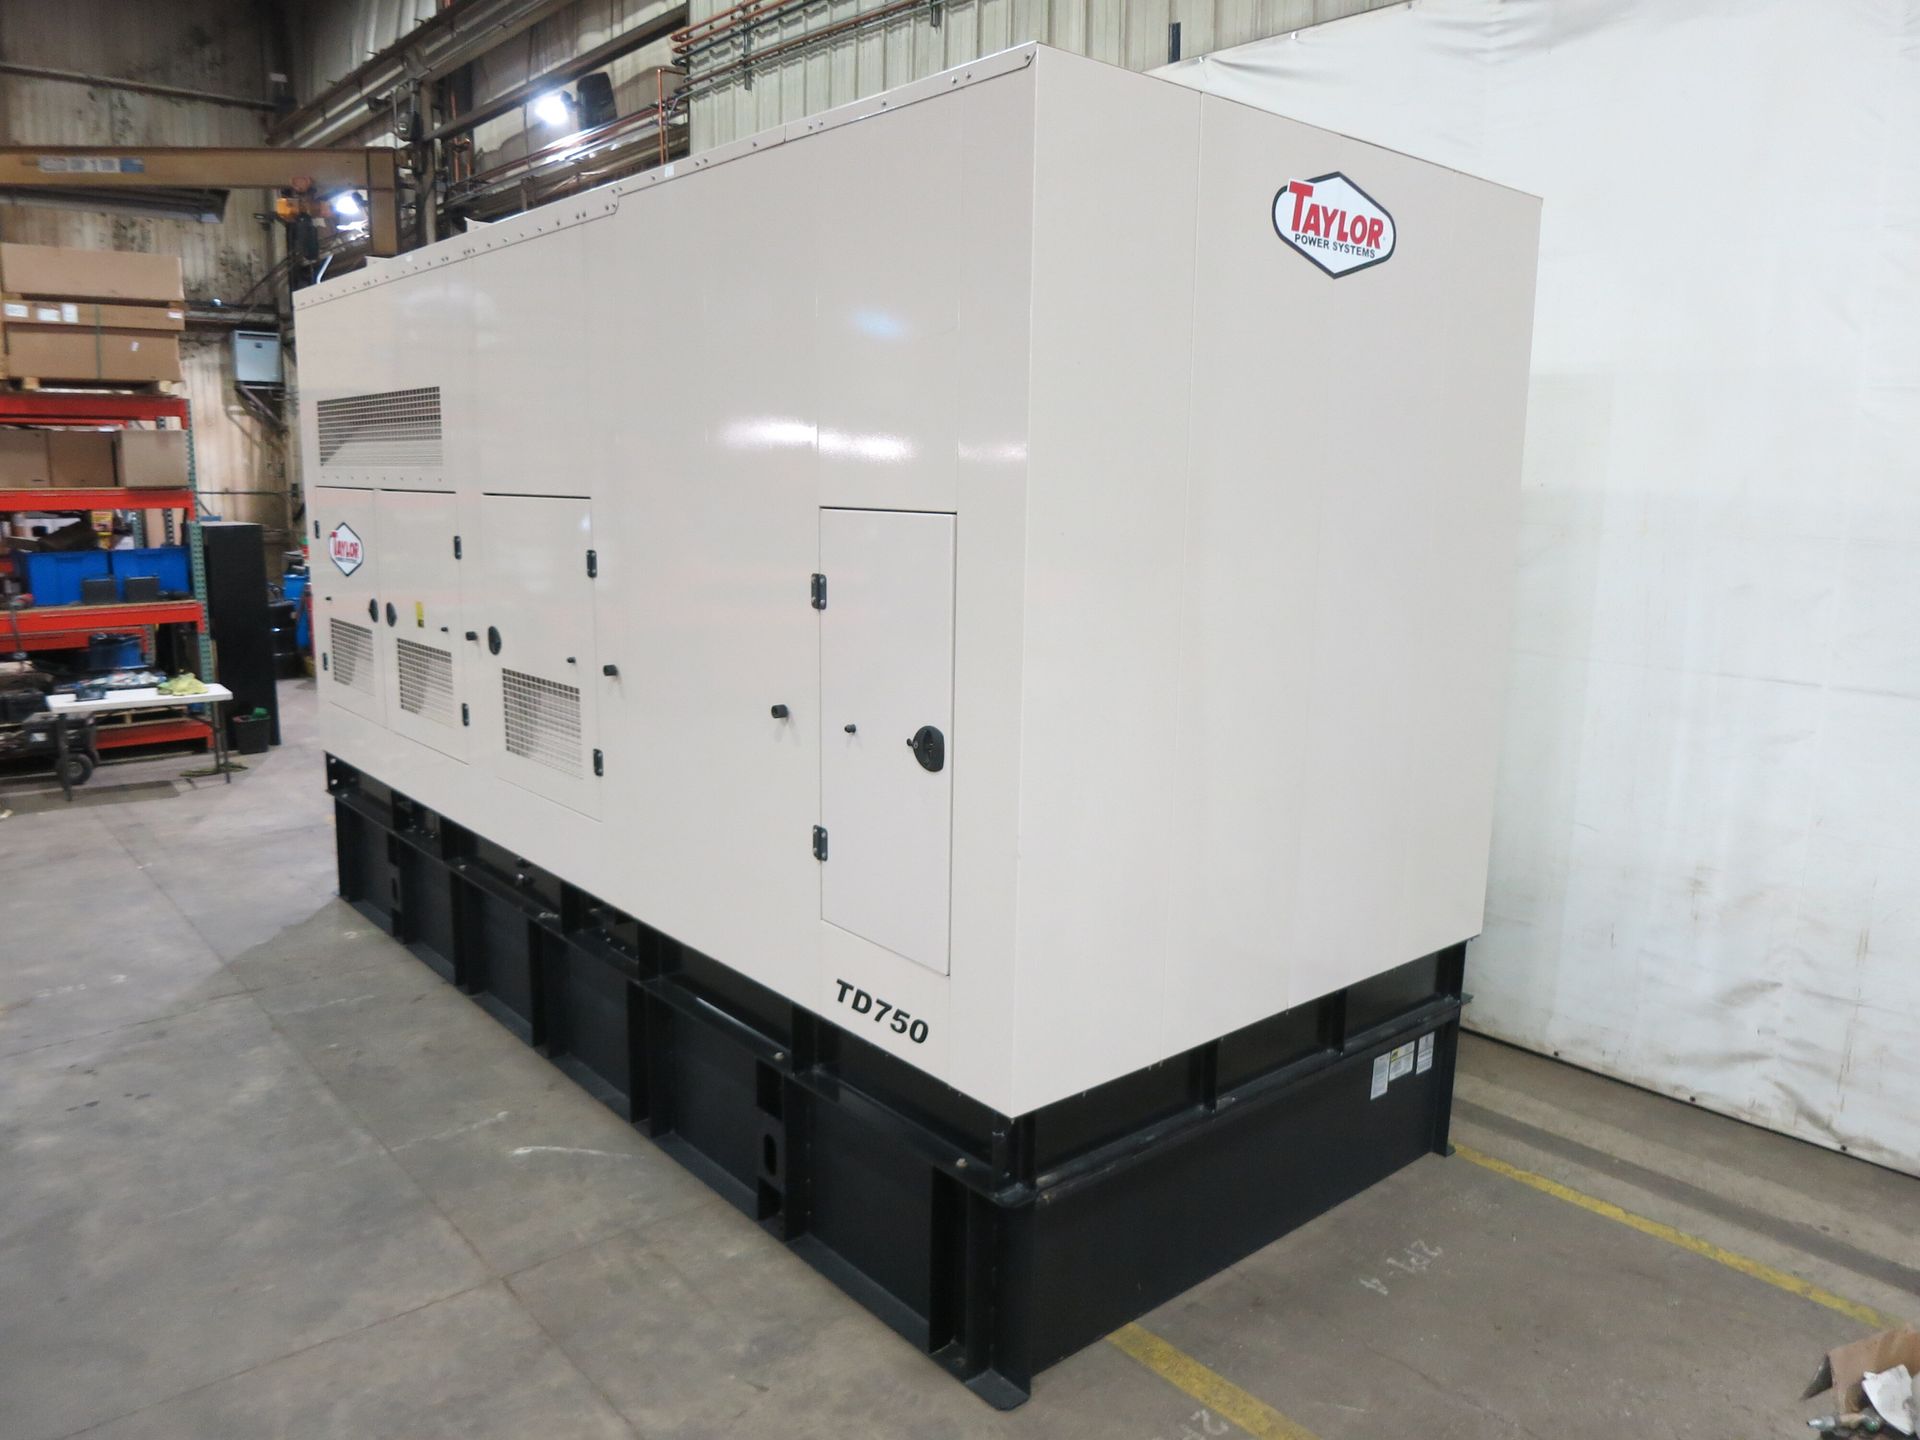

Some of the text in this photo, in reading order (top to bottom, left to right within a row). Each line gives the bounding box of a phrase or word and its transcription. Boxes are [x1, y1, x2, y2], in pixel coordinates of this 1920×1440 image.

[1288, 181, 1384, 249] TAYLOR
[1294, 233, 1376, 259] POWER SYSTEMS
[331, 531, 360, 559] TAYLOR
[836, 978, 929, 1045] TD750
